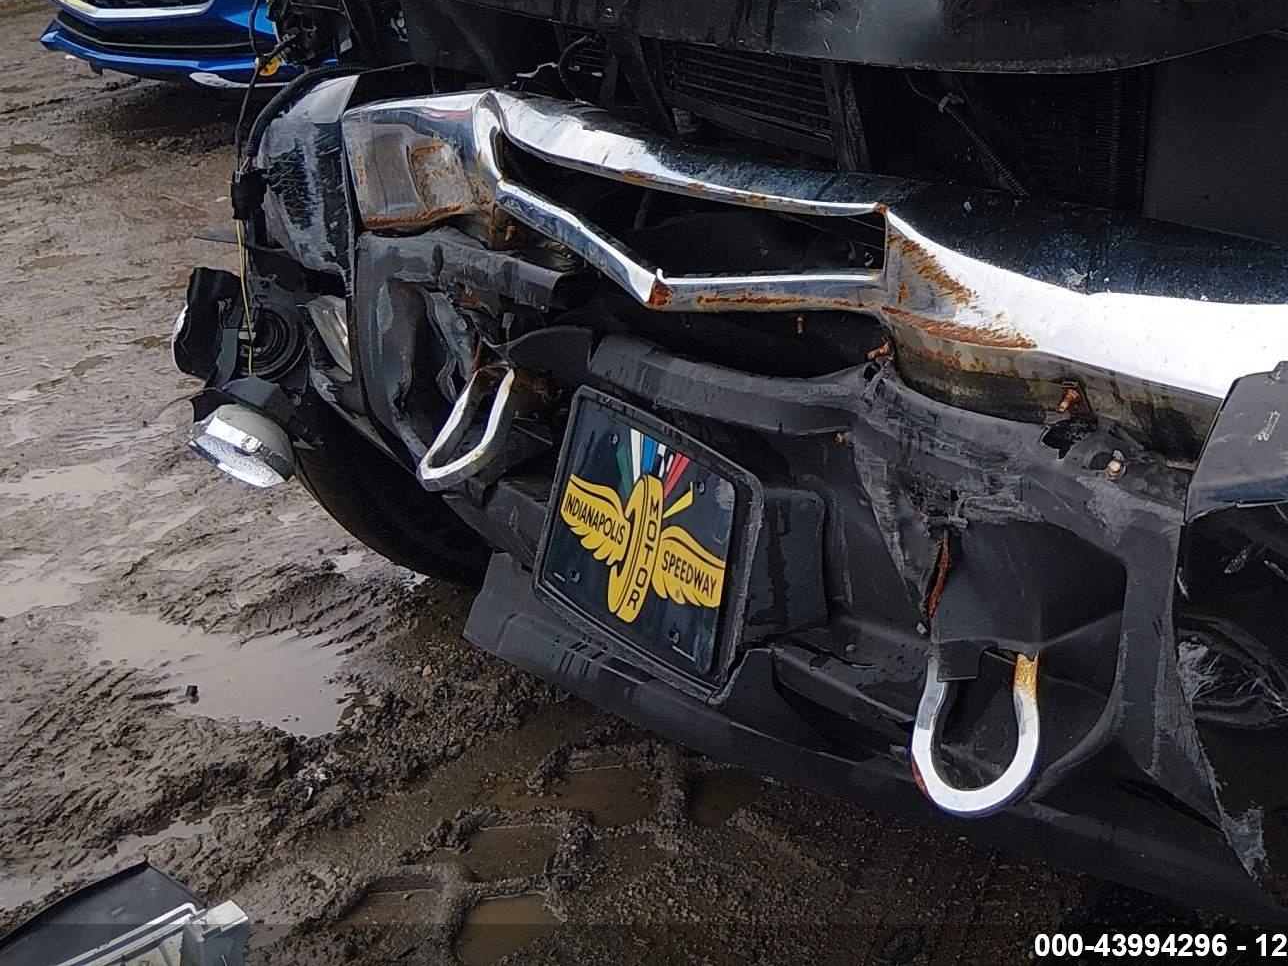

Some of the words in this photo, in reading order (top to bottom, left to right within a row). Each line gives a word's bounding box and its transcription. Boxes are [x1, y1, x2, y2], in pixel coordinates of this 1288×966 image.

[564, 493, 626, 546] INDIANAPOLIS
[627, 496, 659, 610] MOTOR
[661, 550, 717, 600] SPEEDWAY
